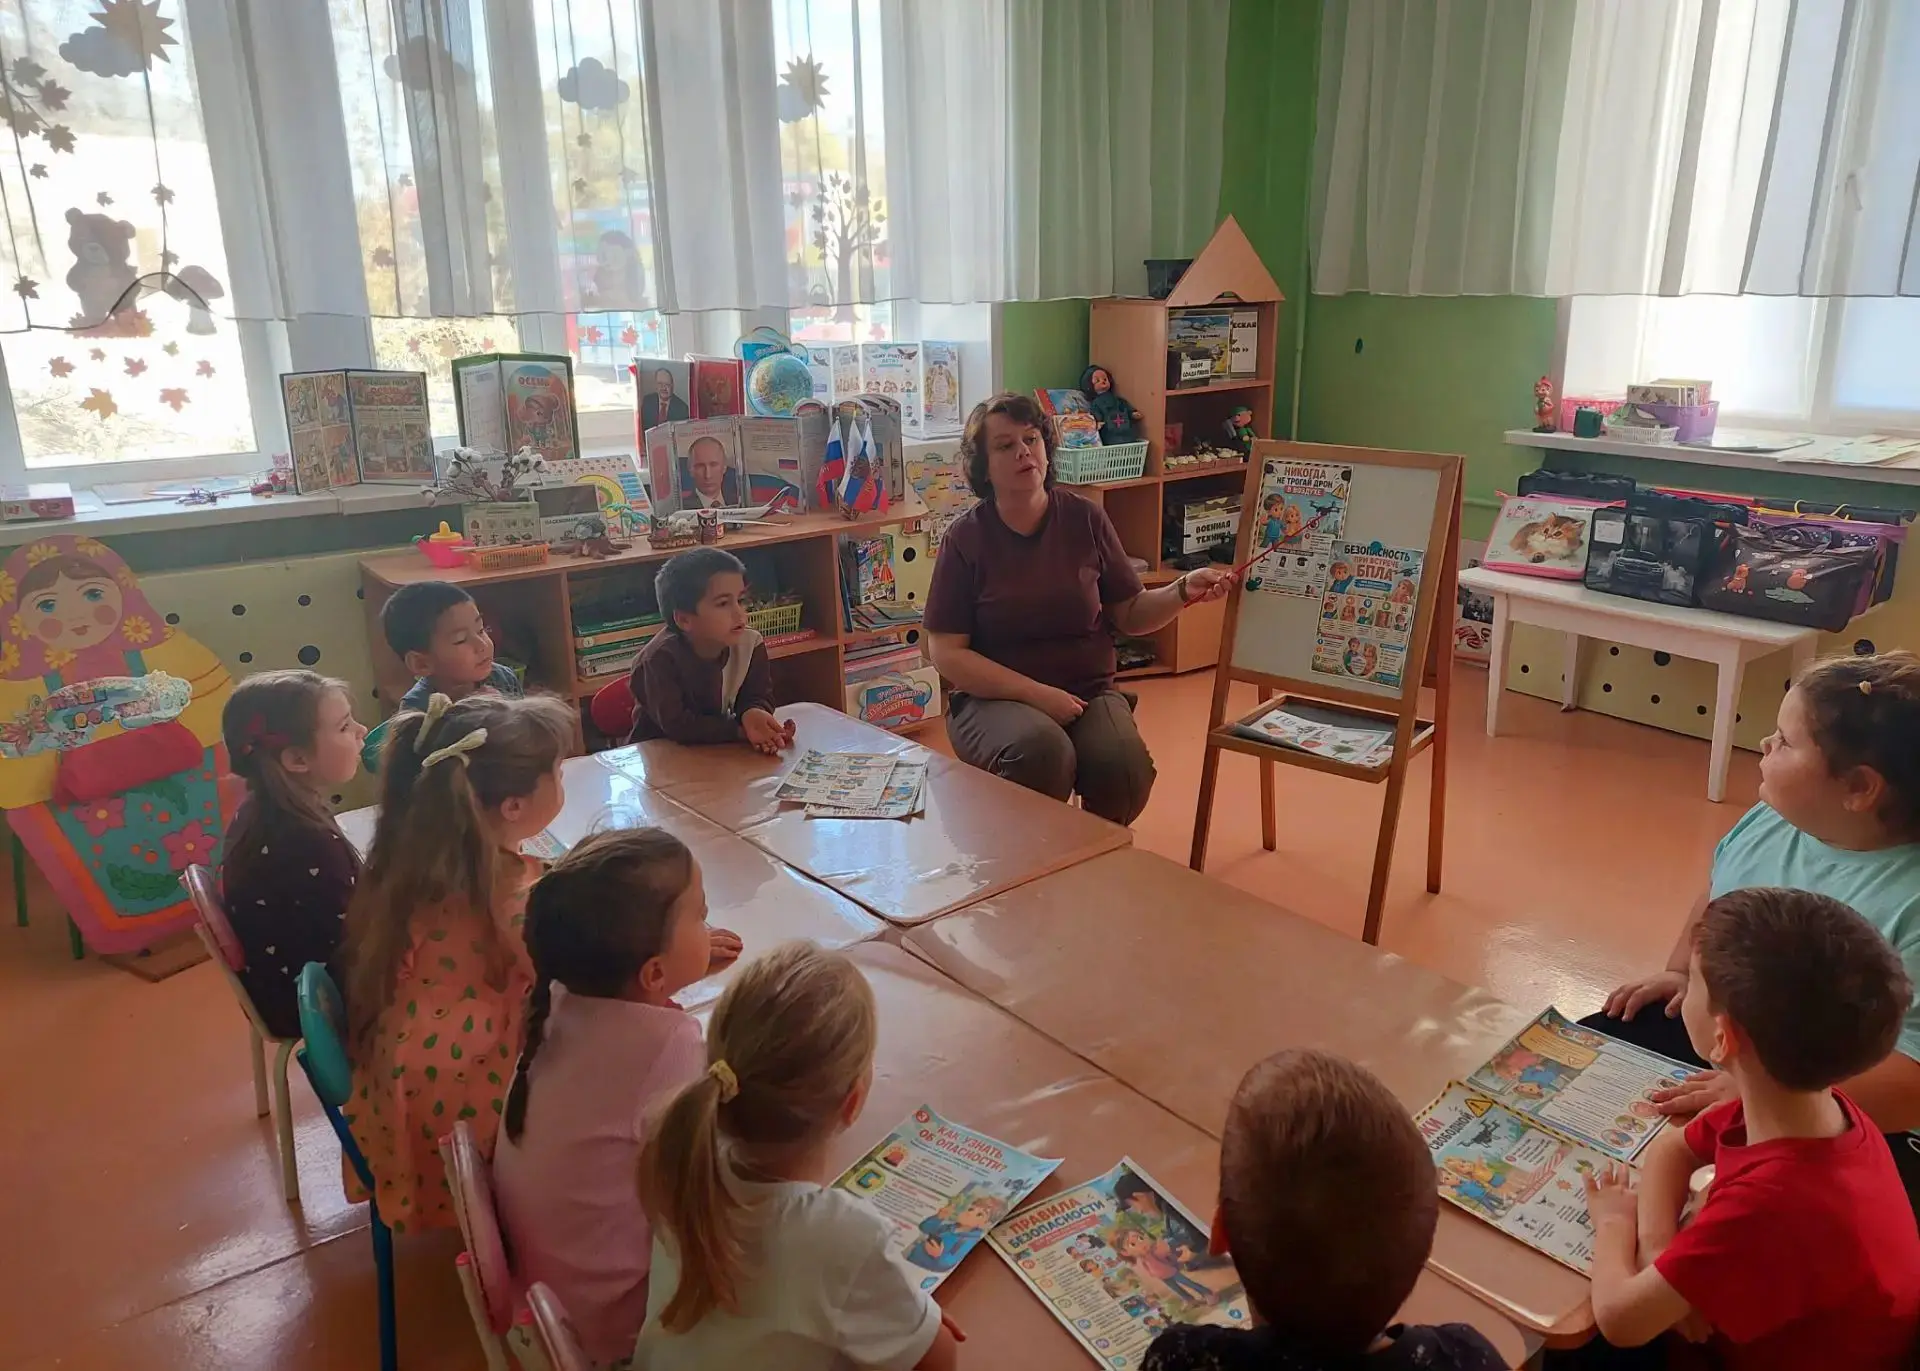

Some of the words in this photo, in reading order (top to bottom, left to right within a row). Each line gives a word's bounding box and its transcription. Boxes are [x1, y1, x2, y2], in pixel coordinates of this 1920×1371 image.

[1232, 321, 1257, 329] ЕСКАЯ
[1276, 477, 1285, 485] НЕ
[1287, 477, 1312, 486] ТРОГАЙ
[1313, 480, 1333, 489] ДРОН
[1284, 466, 1326, 479] НИКОГДА
[1196, 520, 1231, 534] ВОЕННАЯ
[1357, 565, 1393, 581] БПЛА
[937, 1126, 959, 1141] КАК
[962, 1136, 1003, 1158] УЗНАТЬ
[1428, 1110, 1475, 1150] СВОБОДНОЙ
[919, 1129, 934, 1142] ОБ
[936, 1138, 1008, 1172] ОПАСНОСТИ?
[1008, 1199, 1106, 1249] БЕЗОПАСНОСТИ
[1009, 1198, 1081, 1235] ПРАВИЛА
